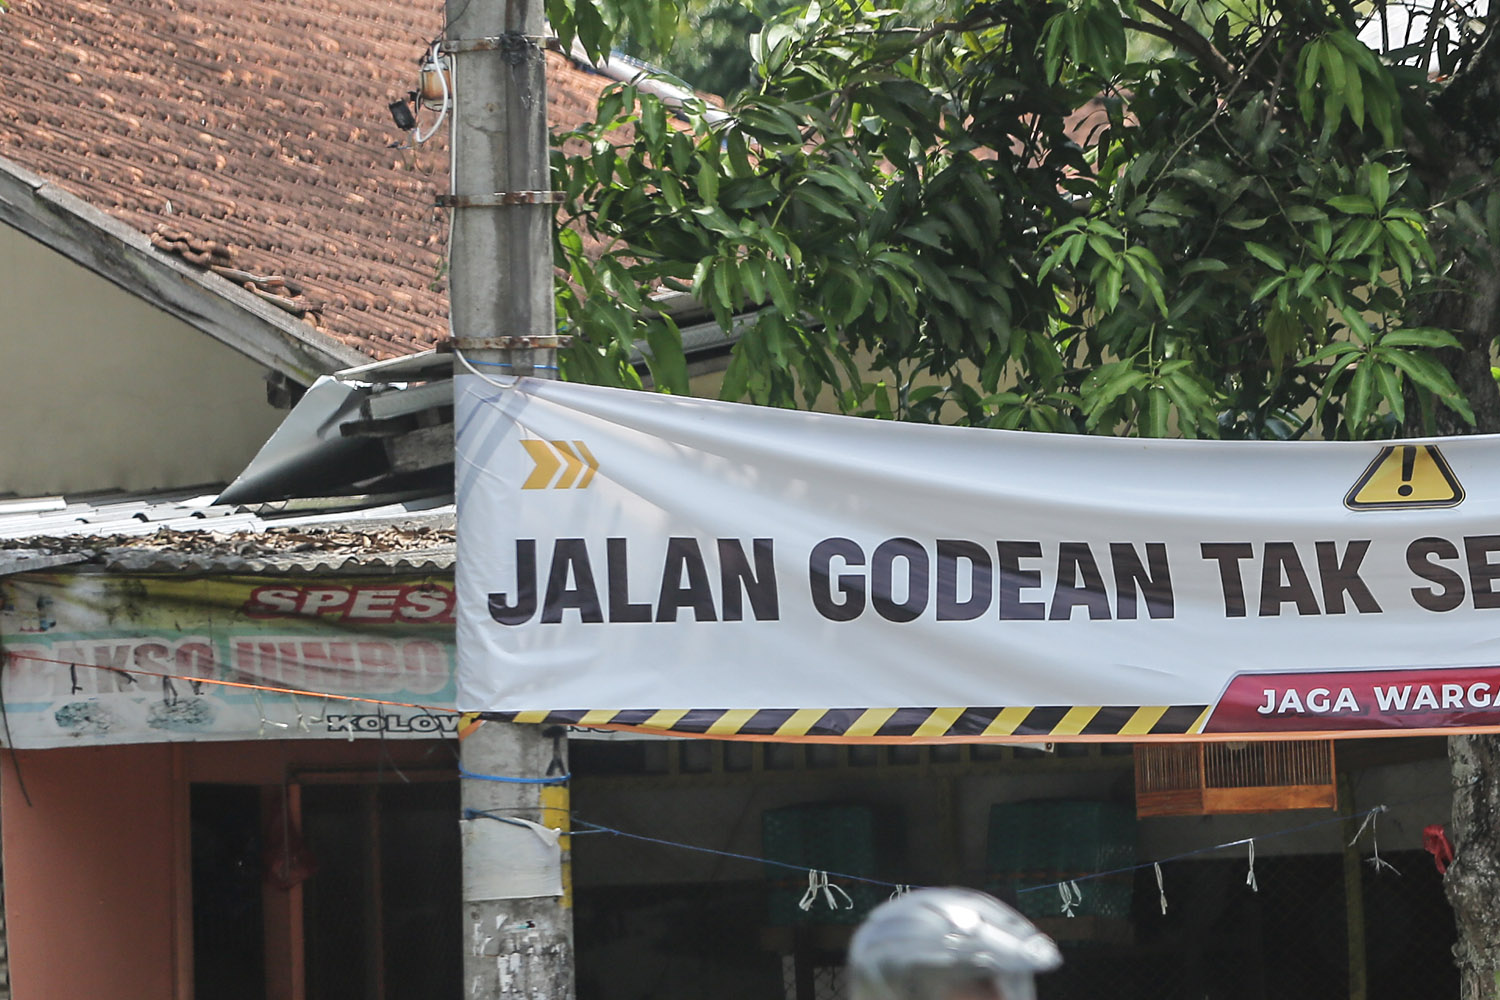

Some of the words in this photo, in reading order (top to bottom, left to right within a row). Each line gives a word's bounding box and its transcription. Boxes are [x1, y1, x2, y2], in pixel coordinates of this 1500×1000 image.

[488, 537, 780, 626] JALAN
[808, 537, 1175, 623] GODEAN
[1200, 539, 1383, 618] TAK
[255, 587, 458, 619] SPES
[1257, 686, 1360, 715] JAGA
